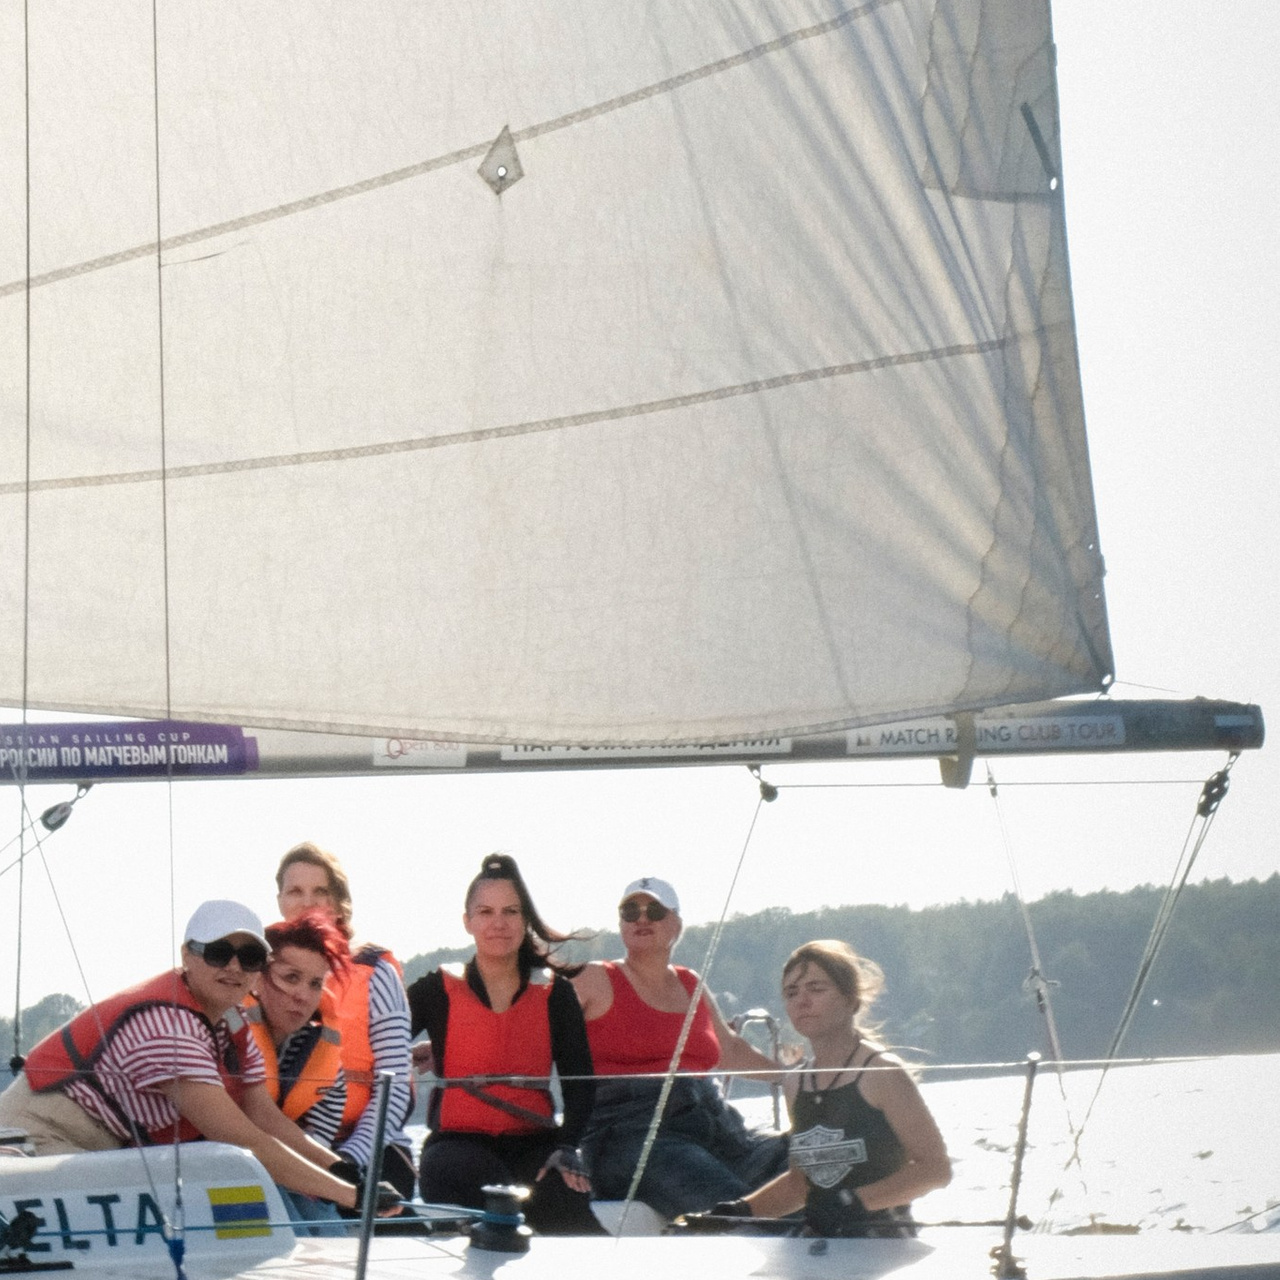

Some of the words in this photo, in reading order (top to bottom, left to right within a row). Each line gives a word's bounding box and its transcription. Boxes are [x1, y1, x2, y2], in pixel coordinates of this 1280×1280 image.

[72, 733, 147, 744] SAILING
[158, 732, 191, 742] CUP
[880, 728, 939, 746] MATCH
[946, 726, 1012, 744] RING
[1018, 723, 1062, 741] CLUB
[60, 746, 81, 766] ПО
[84, 745, 167, 766] МАТЧЕВЫМ
[170, 744, 228, 764] ГОНКАМ
